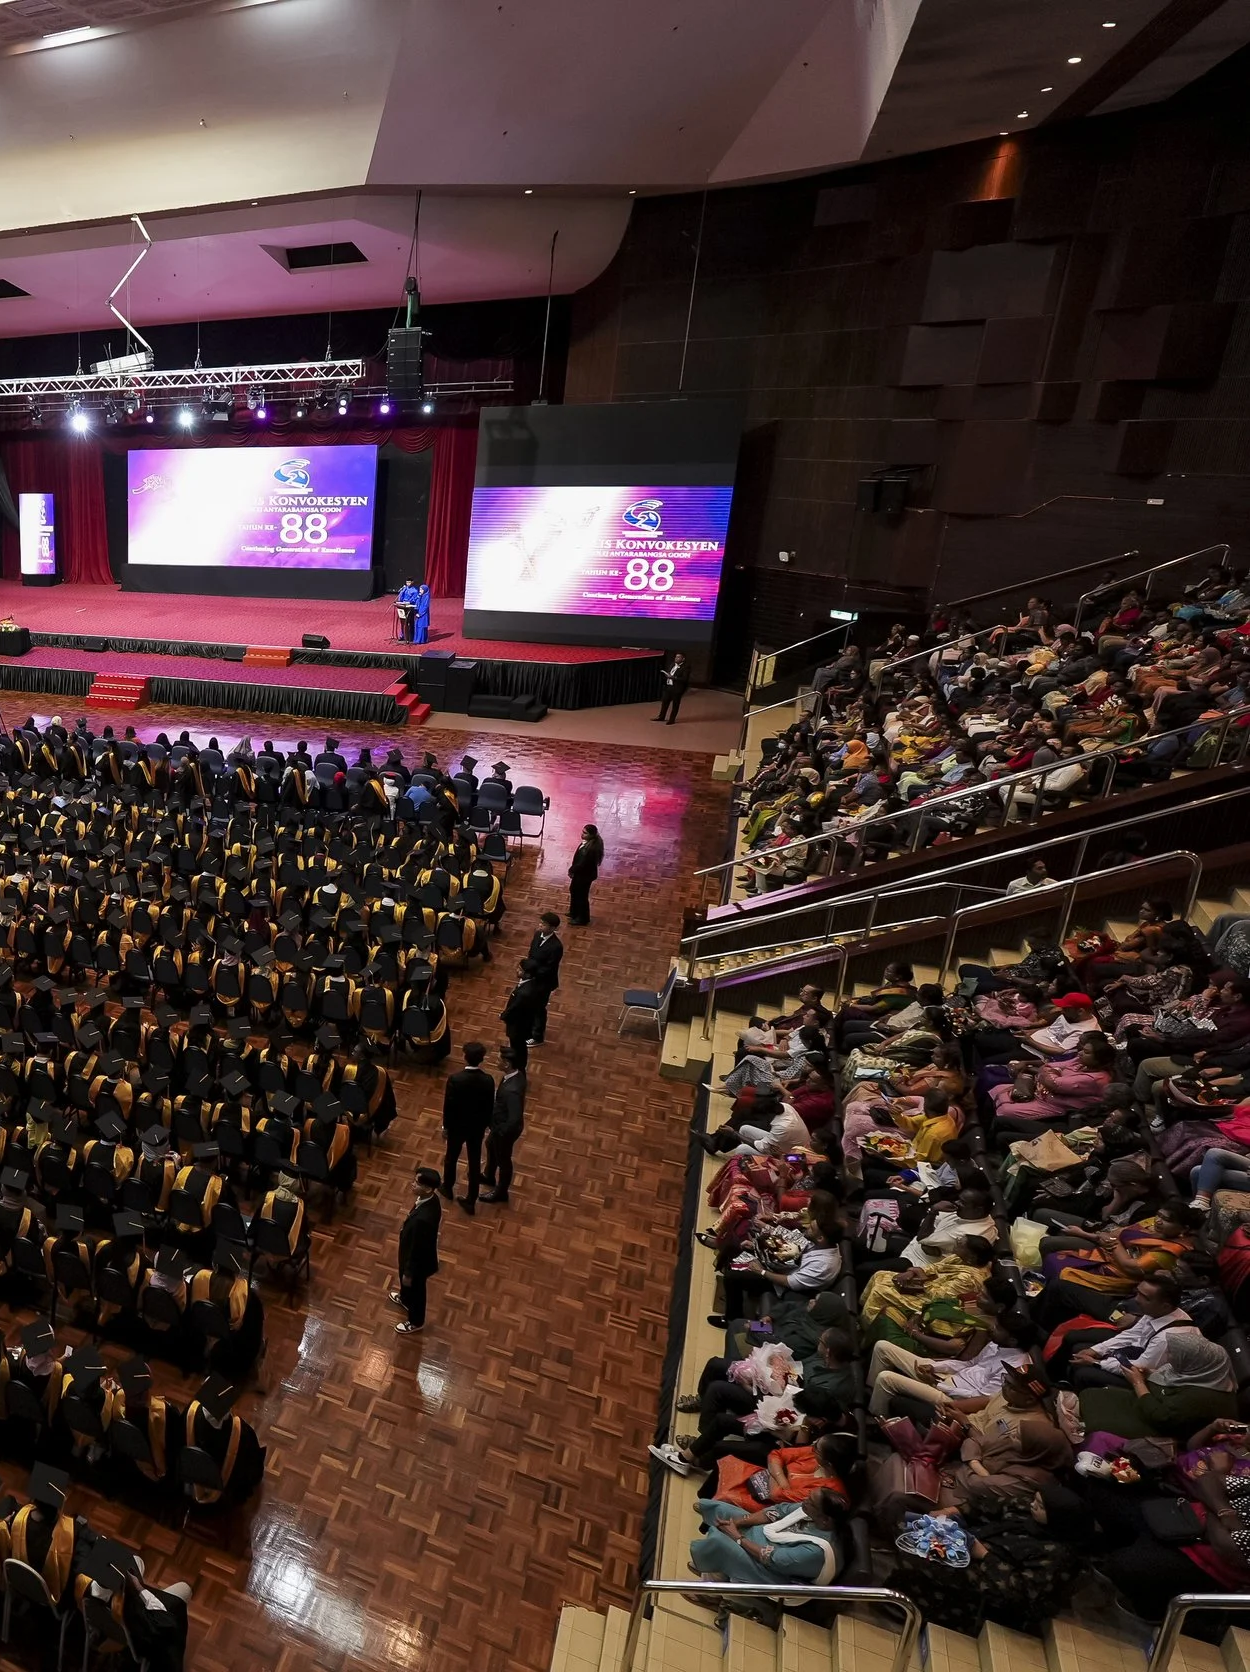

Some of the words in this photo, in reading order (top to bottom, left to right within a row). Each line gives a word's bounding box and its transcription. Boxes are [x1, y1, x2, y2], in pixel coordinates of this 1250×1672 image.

[269, 495, 369, 506] KONVOKESYEN
[279, 513, 328, 545] 88
[240, 545, 275, 554] Continuing
[615, 539, 719, 552] KONVOKESYEN
[610, 550, 668, 558] ANTARABANGSA
[623, 558, 675, 591] 88
[582, 591, 617, 600] Continuing
